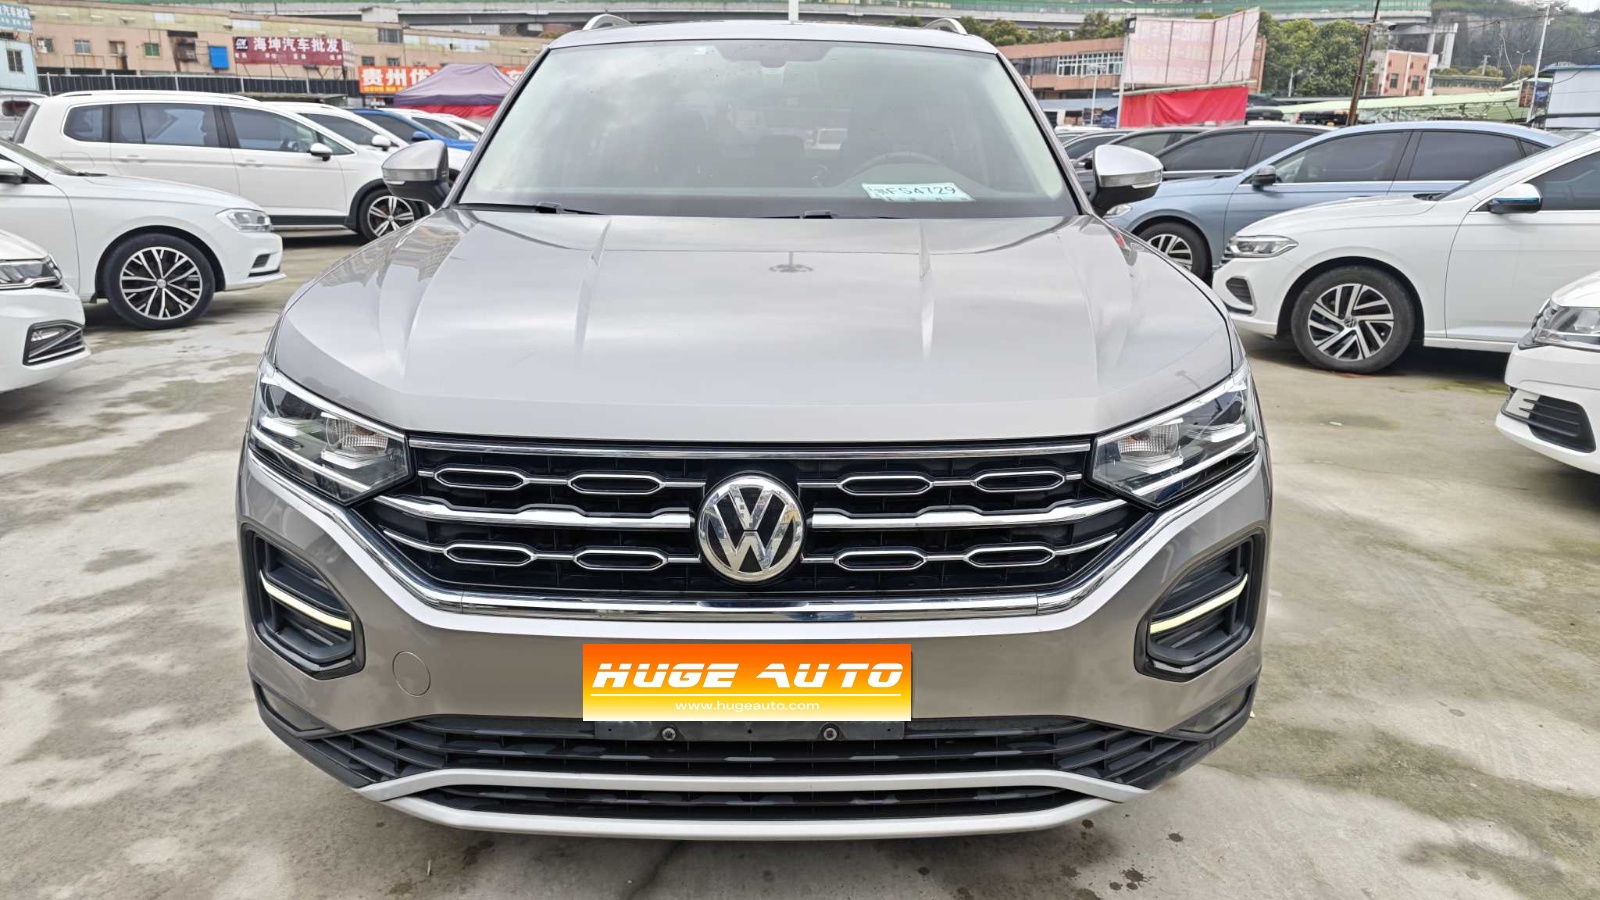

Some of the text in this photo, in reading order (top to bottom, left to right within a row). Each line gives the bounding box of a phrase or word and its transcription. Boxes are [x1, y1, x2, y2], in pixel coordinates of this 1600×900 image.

[253, 37, 339, 52] 海坤汽车批发
[361, 67, 438, 87] 贵州优
